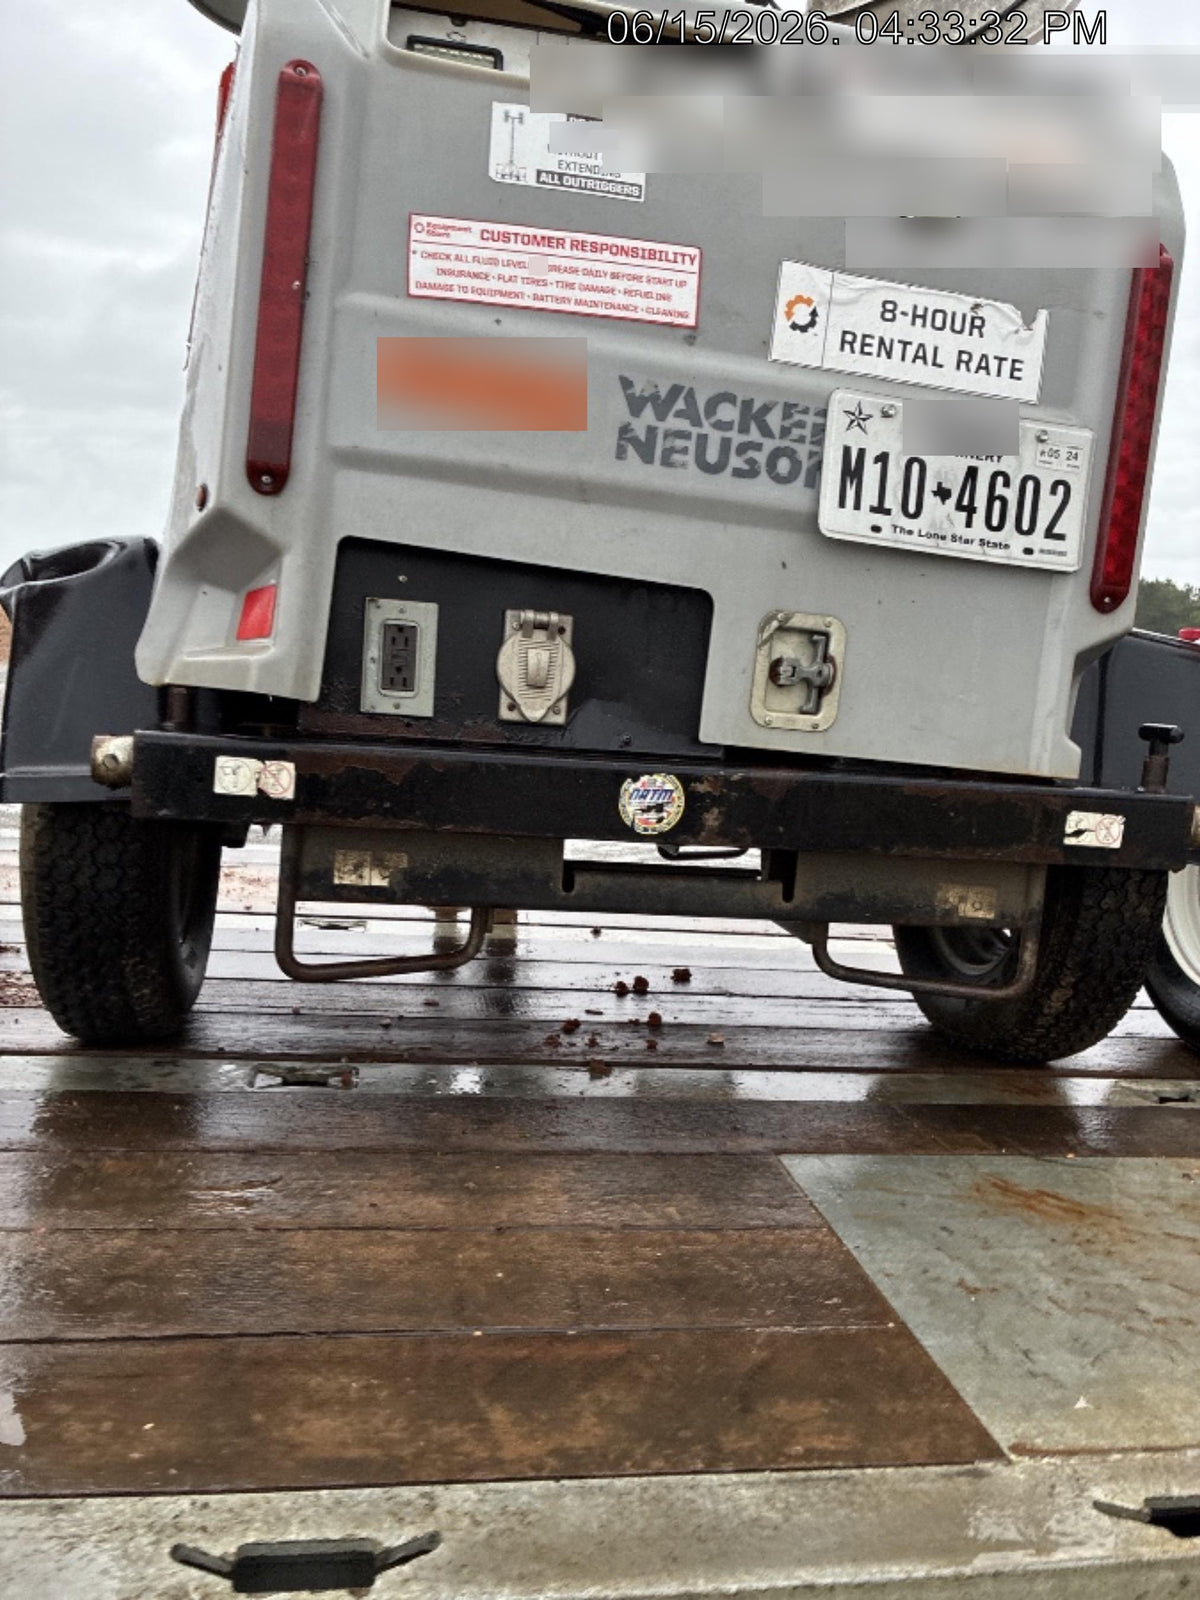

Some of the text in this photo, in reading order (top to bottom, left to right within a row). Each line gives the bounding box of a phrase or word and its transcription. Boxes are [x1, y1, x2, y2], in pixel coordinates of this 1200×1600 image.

[540, 172, 641, 196] ALL OUTRIGGERS
[480, 229, 697, 266] CUSTOMER RESPONSIBILITY
[420, 250, 452, 262] CHECK
[454, 253, 470, 264] ALL
[581, 267, 609, 280] DAILY
[644, 275, 674, 287] START
[674, 279, 687, 288] UP
[436, 267, 491, 282] INSURANCE
[497, 272, 519, 284] FLAT
[520, 275, 549, 288] TIRES
[577, 283, 617, 296] DAMAGE
[415, 280, 690, 320] DAMAGE TO EQUIPMENT BATTERY MAINTENANCE CLEANING
[879, 299, 987, 338] 8-HOUR
[838, 329, 1026, 382] RENTAL RATE
[1065, 450, 1080, 462] 24
[891, 524, 1011, 550] The Lone Star State
